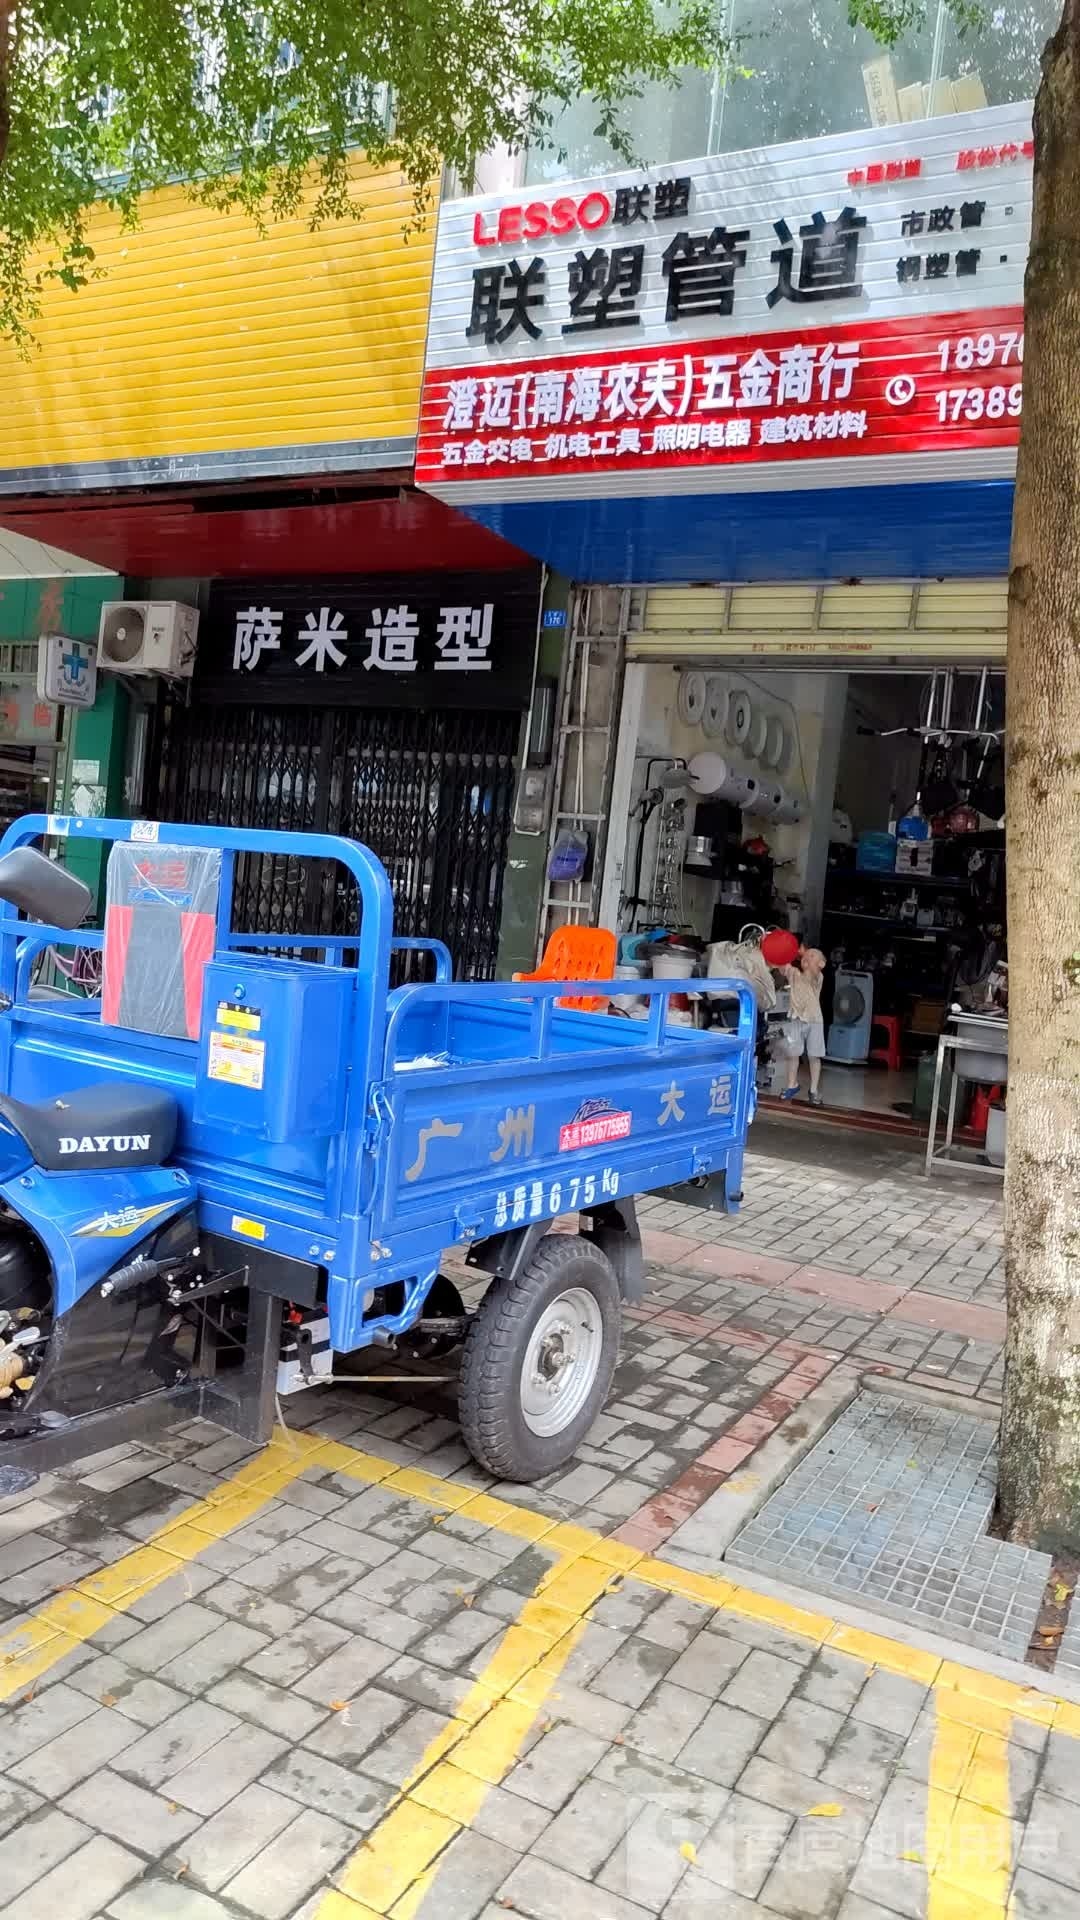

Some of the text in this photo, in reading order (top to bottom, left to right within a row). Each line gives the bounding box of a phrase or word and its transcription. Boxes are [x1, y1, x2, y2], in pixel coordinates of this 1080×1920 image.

[472, 177, 691, 246] LESSO 联塑
[901, 200, 986, 237] 市政管
[466, 207, 867, 344] 联塑管道
[935, 383, 1023, 422] 17389
[441, 410, 868, 465] 五金交电 机电工具 照明电器 建筑材料
[233, 603, 494, 672] 萨米造型
[58, 1135, 151, 1154] DAYUN
[405, 1076, 732, 1182] 广州 大运
[98, 1205, 138, 1232] 大运
